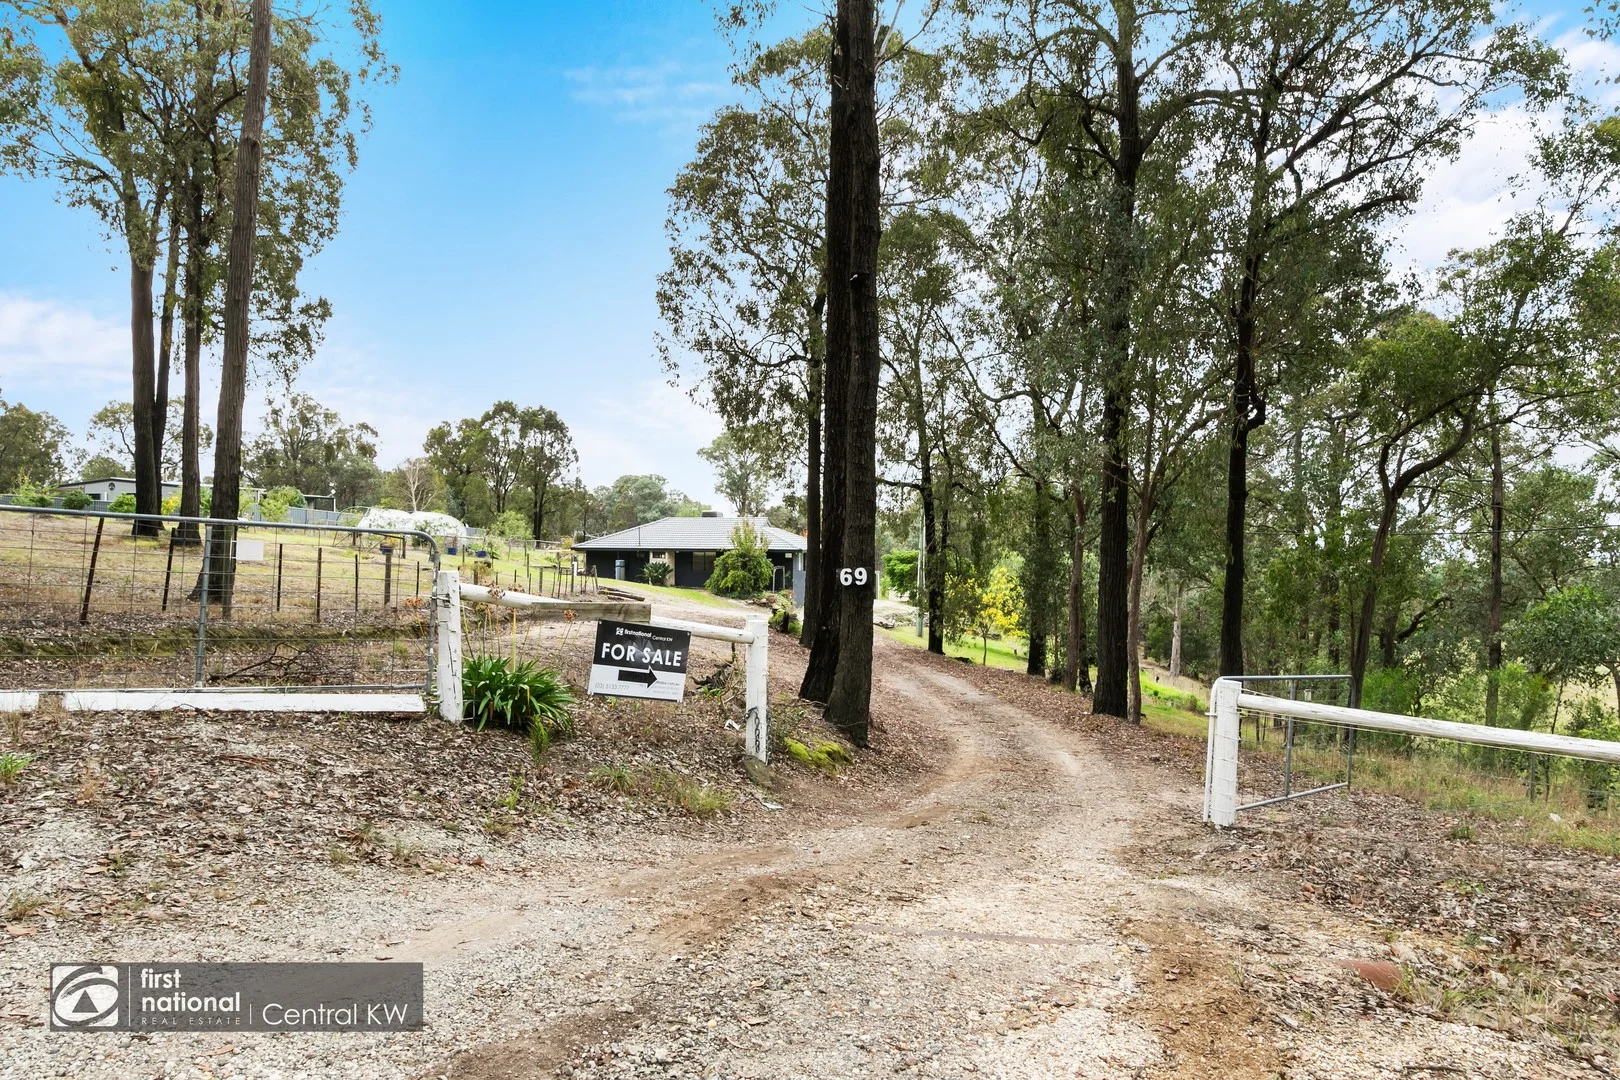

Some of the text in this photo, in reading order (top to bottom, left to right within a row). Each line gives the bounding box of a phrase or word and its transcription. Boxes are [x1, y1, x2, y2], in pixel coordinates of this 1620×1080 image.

[840, 567, 867, 586] 69
[601, 642, 682, 667] FOR SALE
